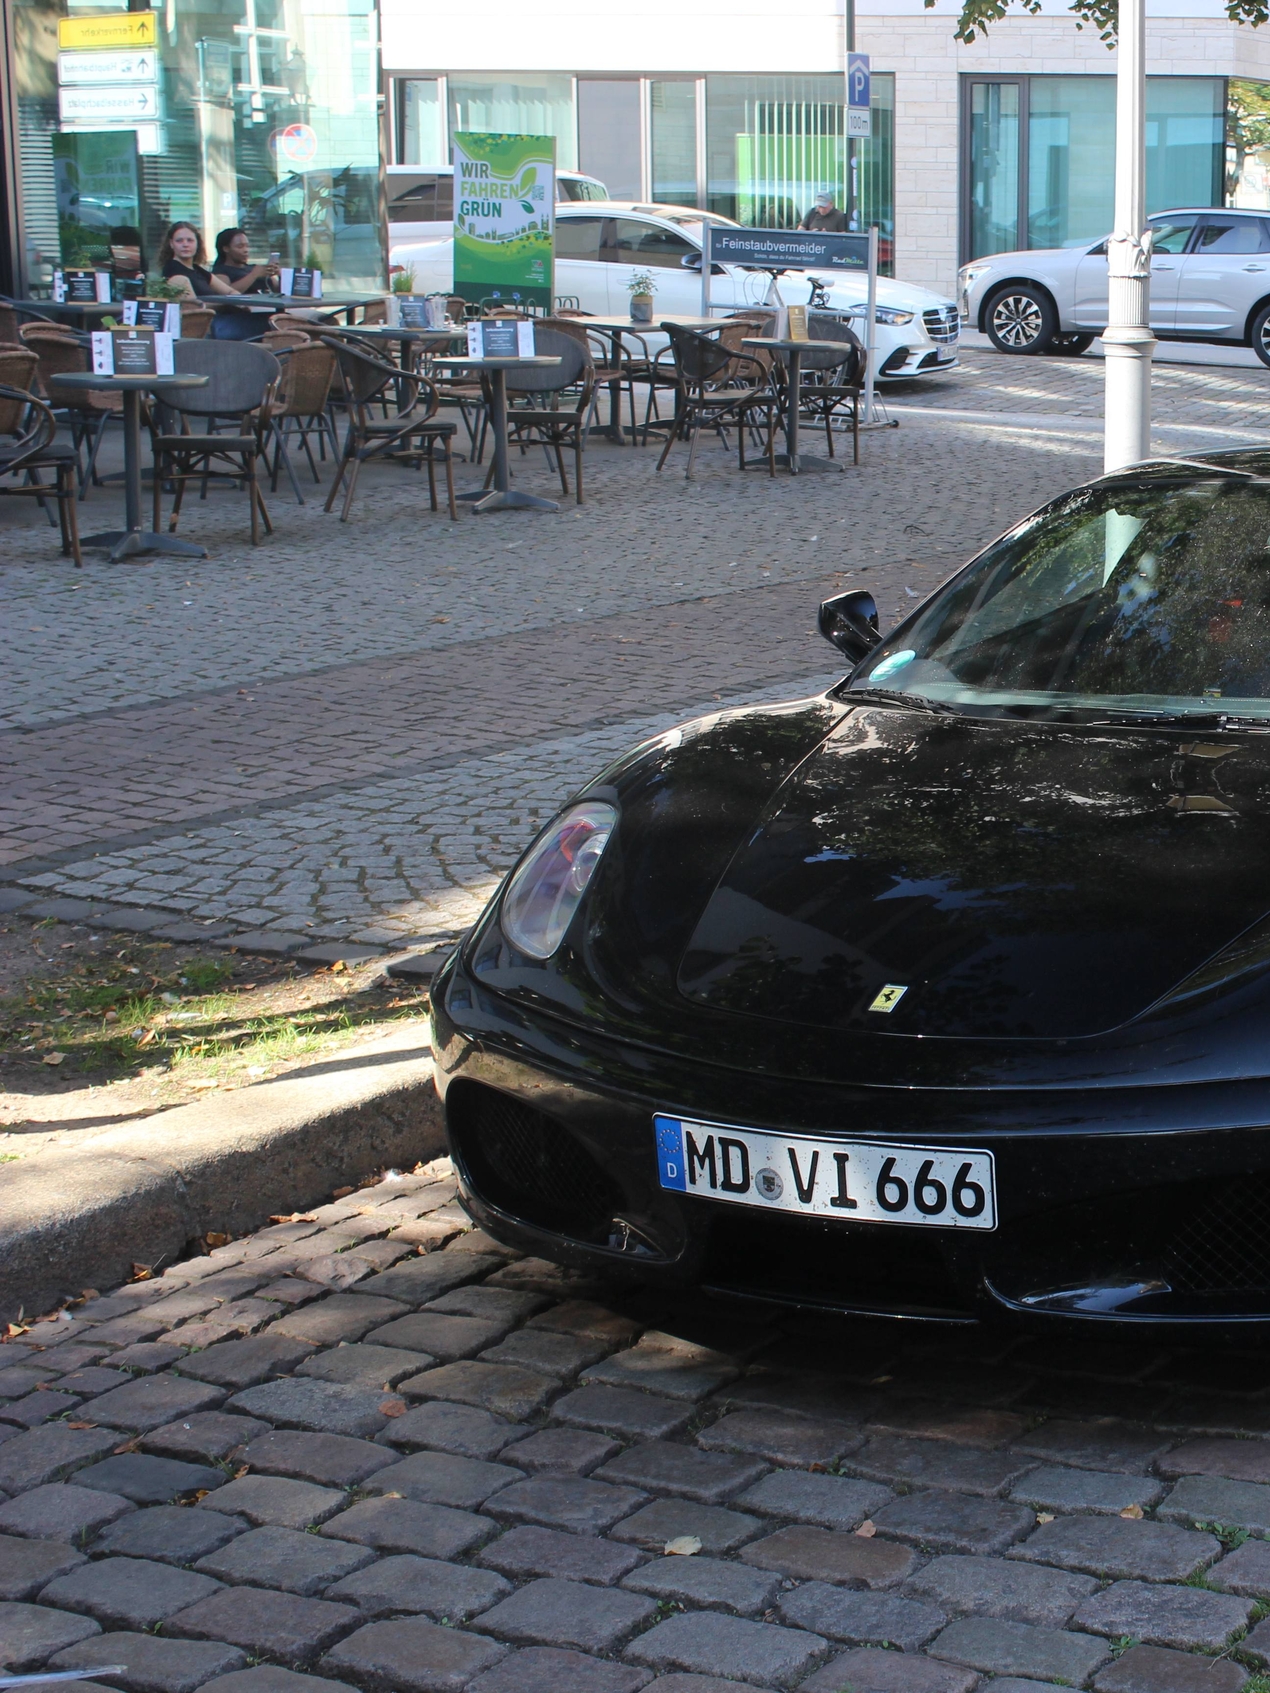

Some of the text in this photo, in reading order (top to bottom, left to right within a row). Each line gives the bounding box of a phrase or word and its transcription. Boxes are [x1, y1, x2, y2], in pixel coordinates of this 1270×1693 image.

[854, 71, 865, 102] P
[460, 162, 490, 179] WIR
[460, 181, 519, 199] FAHREN
[460, 198, 502, 218] GRÜN
[722, 237, 826, 255] Feinstaubvermeider
[667, 1162, 678, 1178] D
[685, 1130, 751, 1193] MD
[787, 1147, 858, 1210] VI
[876, 1157, 986, 1218] 666
